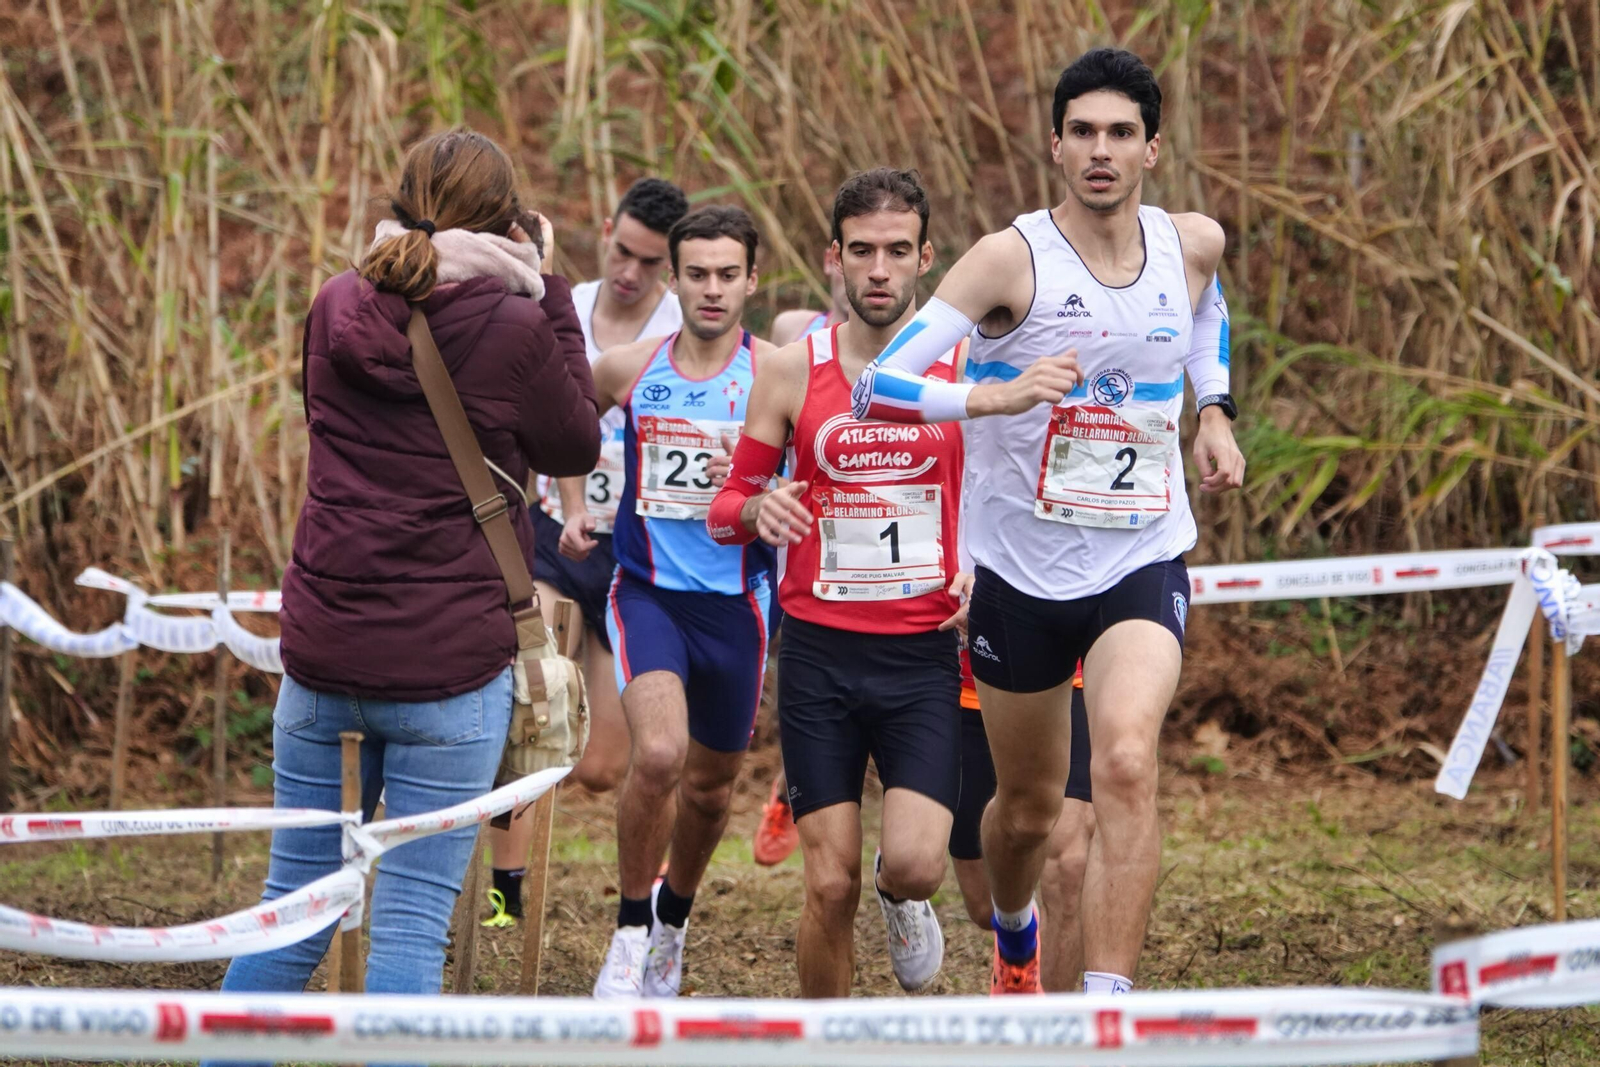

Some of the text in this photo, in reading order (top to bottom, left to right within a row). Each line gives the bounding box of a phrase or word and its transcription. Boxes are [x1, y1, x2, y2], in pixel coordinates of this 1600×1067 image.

[1090, 368, 1110, 386] SOCIEDAD
[1074, 412, 1124, 426] MEMORIAL
[838, 427, 920, 445] ATLETISMO
[1072, 426, 1159, 443] BELARMINO ALONSO
[664, 450, 713, 490] 23
[838, 452, 912, 468] SANTIAGO
[1110, 446, 1138, 490] 2
[590, 472, 610, 504] 3
[833, 493, 880, 504] MEMORIAL
[834, 506, 920, 518] BELARMINO ALONSO
[880, 521, 900, 564] 1
[1277, 572, 1328, 588] CONCELLO
[1331, 572, 1343, 584] DE
[31, 1006, 64, 1032] DE
[76, 1006, 148, 1035] VIGO
[353, 1012, 501, 1041] CONCELLO
[512, 1014, 545, 1041] DE
[554, 1014, 623, 1041] VIGO
[822, 1014, 968, 1043] CONCELLO
[978, 1014, 1010, 1043] DE
[1012, 1014, 1085, 1045] VIGO
[1275, 1009, 1415, 1037] CONCELLO
